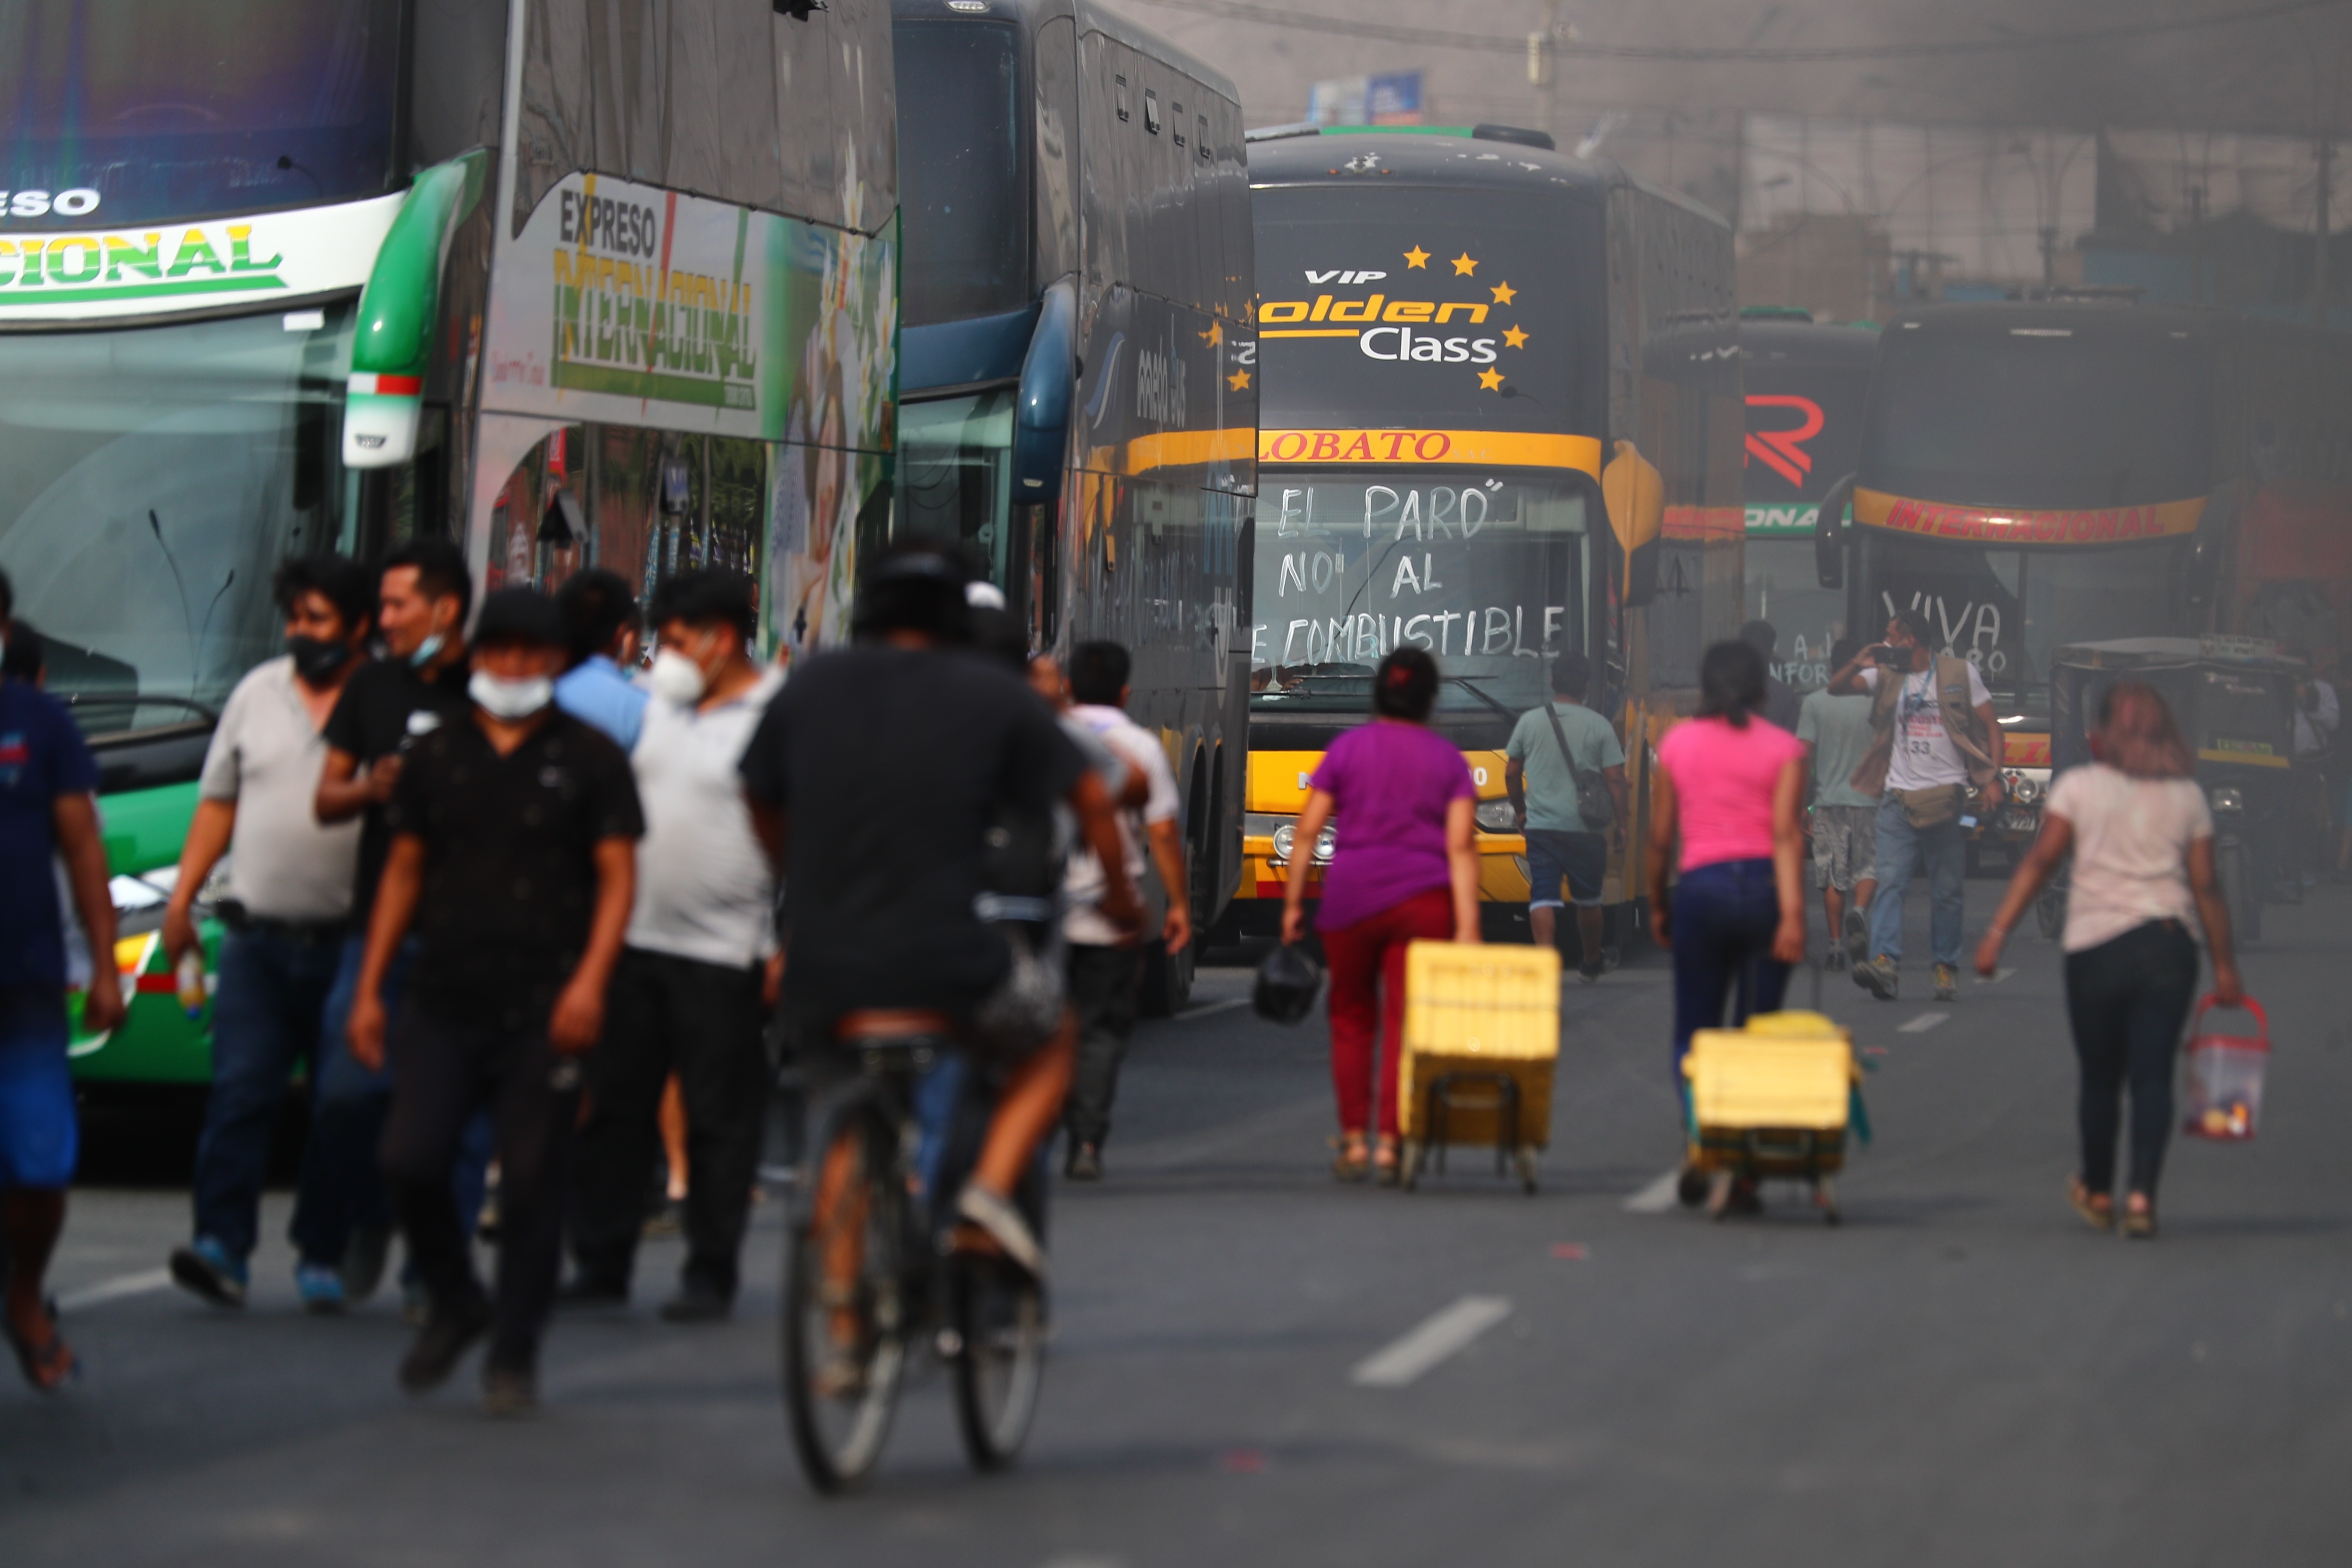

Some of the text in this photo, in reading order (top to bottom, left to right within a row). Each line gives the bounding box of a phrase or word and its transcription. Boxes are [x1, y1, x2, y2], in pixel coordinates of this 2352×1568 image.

[0, 187, 101, 217] SO
[560, 189, 655, 259] EXPRESO
[1305, 270, 1387, 284] VIP
[552, 248, 756, 380] INTERNACIONAL
[1259, 294, 1489, 324] olden
[1360, 327, 1497, 364] Class
[1278, 486, 1330, 539] EL
[1886, 499, 2165, 542] INTERNACIONAL
[1279, 551, 1442, 598] NO AL
[1282, 605, 1566, 669] COMBUSTIBLE
[1769, 662, 1830, 685] NFOR
[1911, 741, 1930, 754] 33
